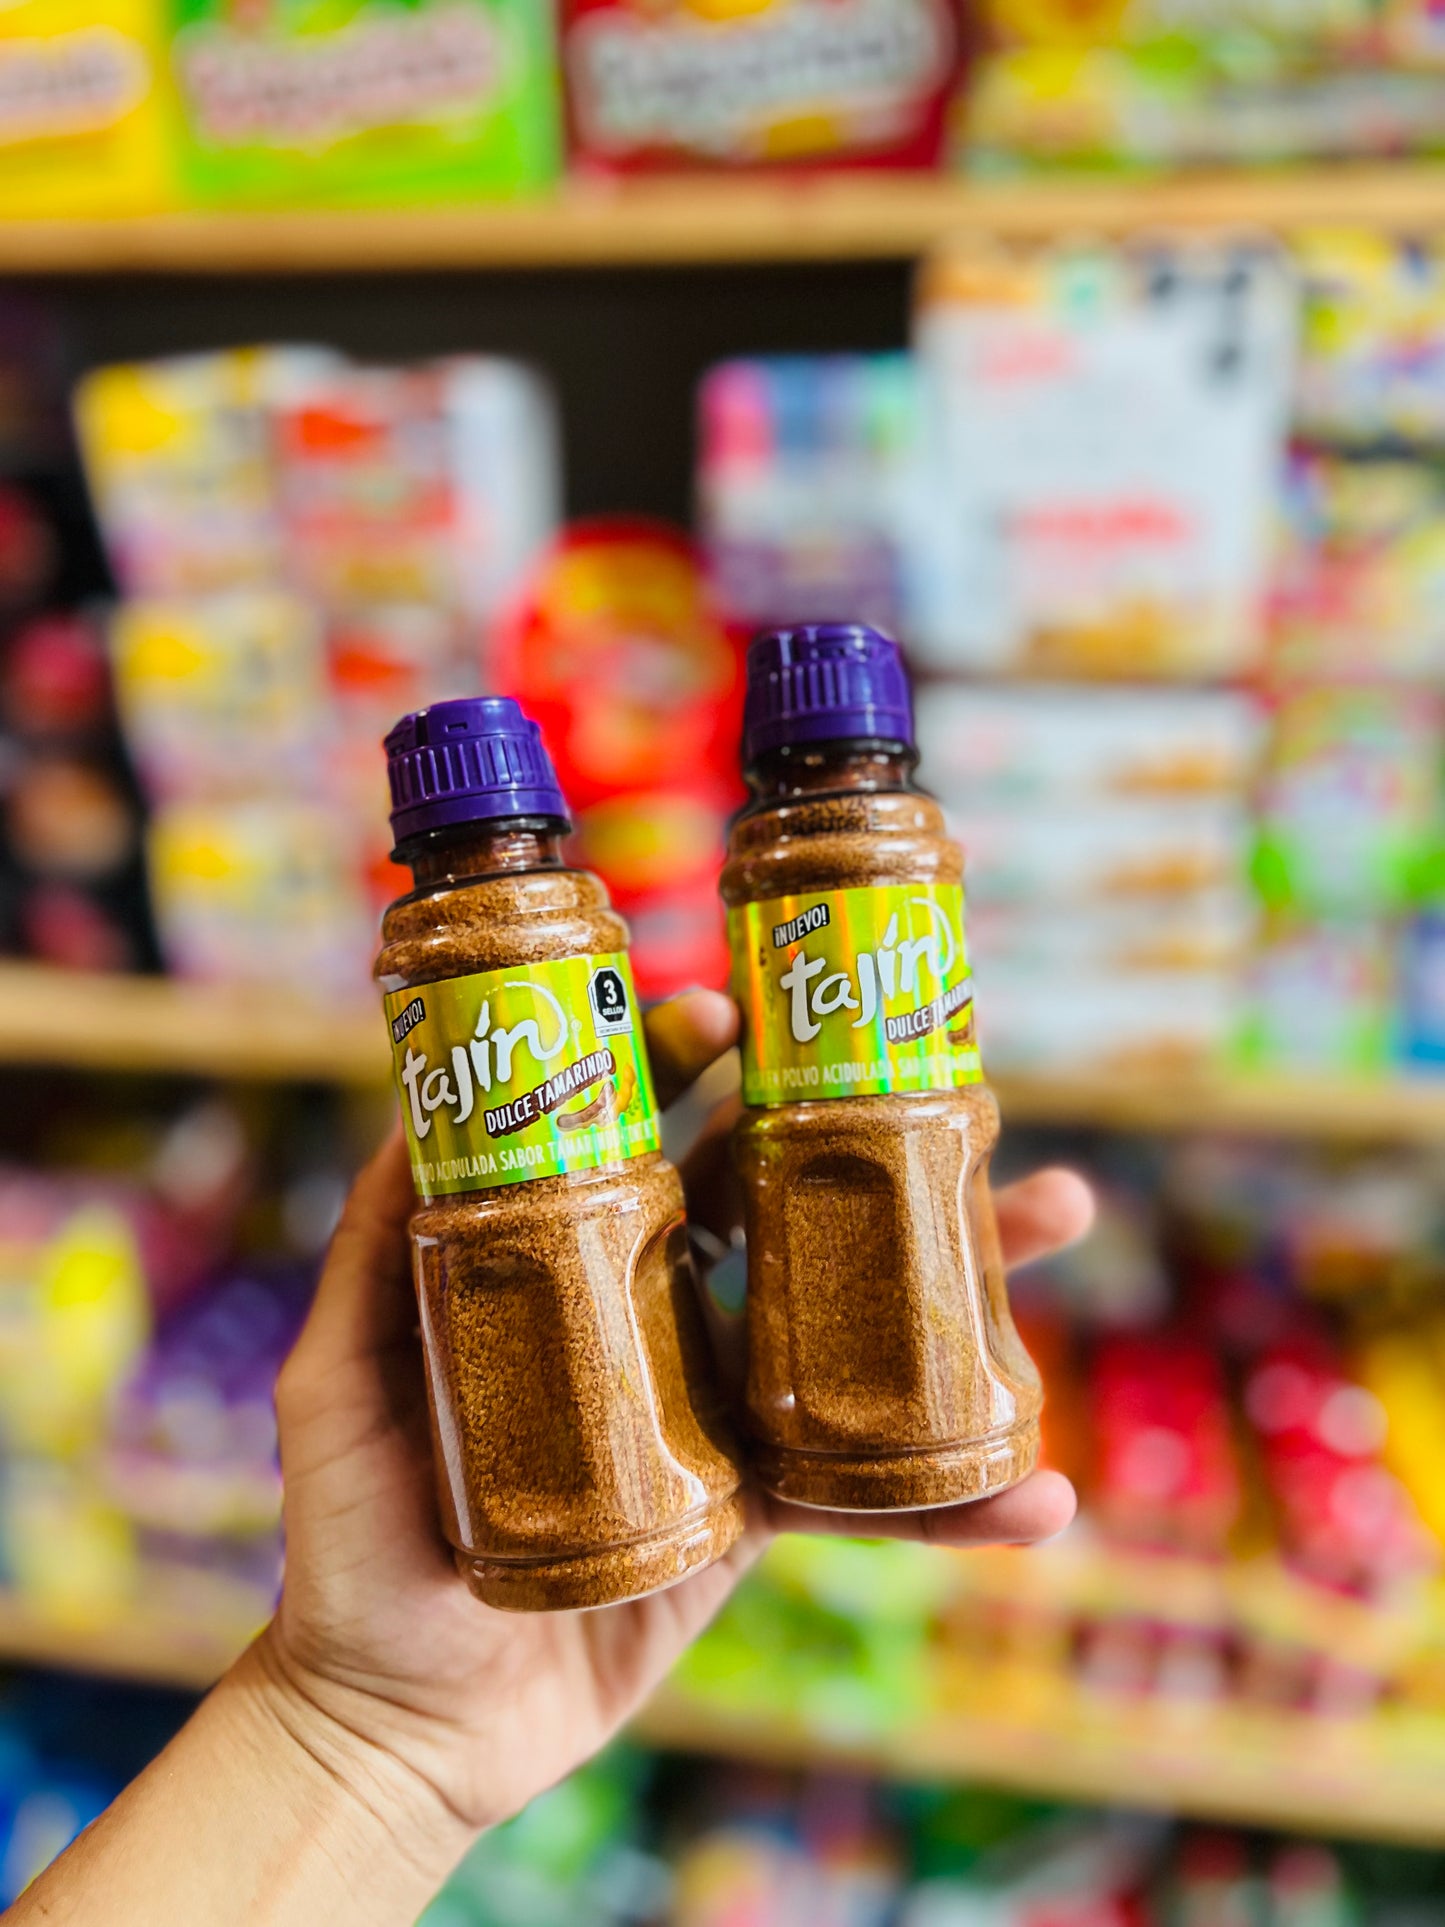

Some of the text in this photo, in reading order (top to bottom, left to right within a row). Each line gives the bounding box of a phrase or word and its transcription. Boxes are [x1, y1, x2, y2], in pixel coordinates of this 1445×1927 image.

[773, 905, 828, 948] ¡NUEVO!
[780, 896, 955, 1043] tajín
[602, 1005, 625, 1016] SELLOS
[603, 978, 618, 1005] 3
[886, 1006, 931, 1041] DULCE
[402, 980, 568, 1139] tajín
[782, 1065, 819, 1088] POLVO
[485, 1049, 612, 1133] DULCE TAMARINDO
[436, 1153, 498, 1181] ACIDULADA
[499, 1143, 545, 1172] SABOR
